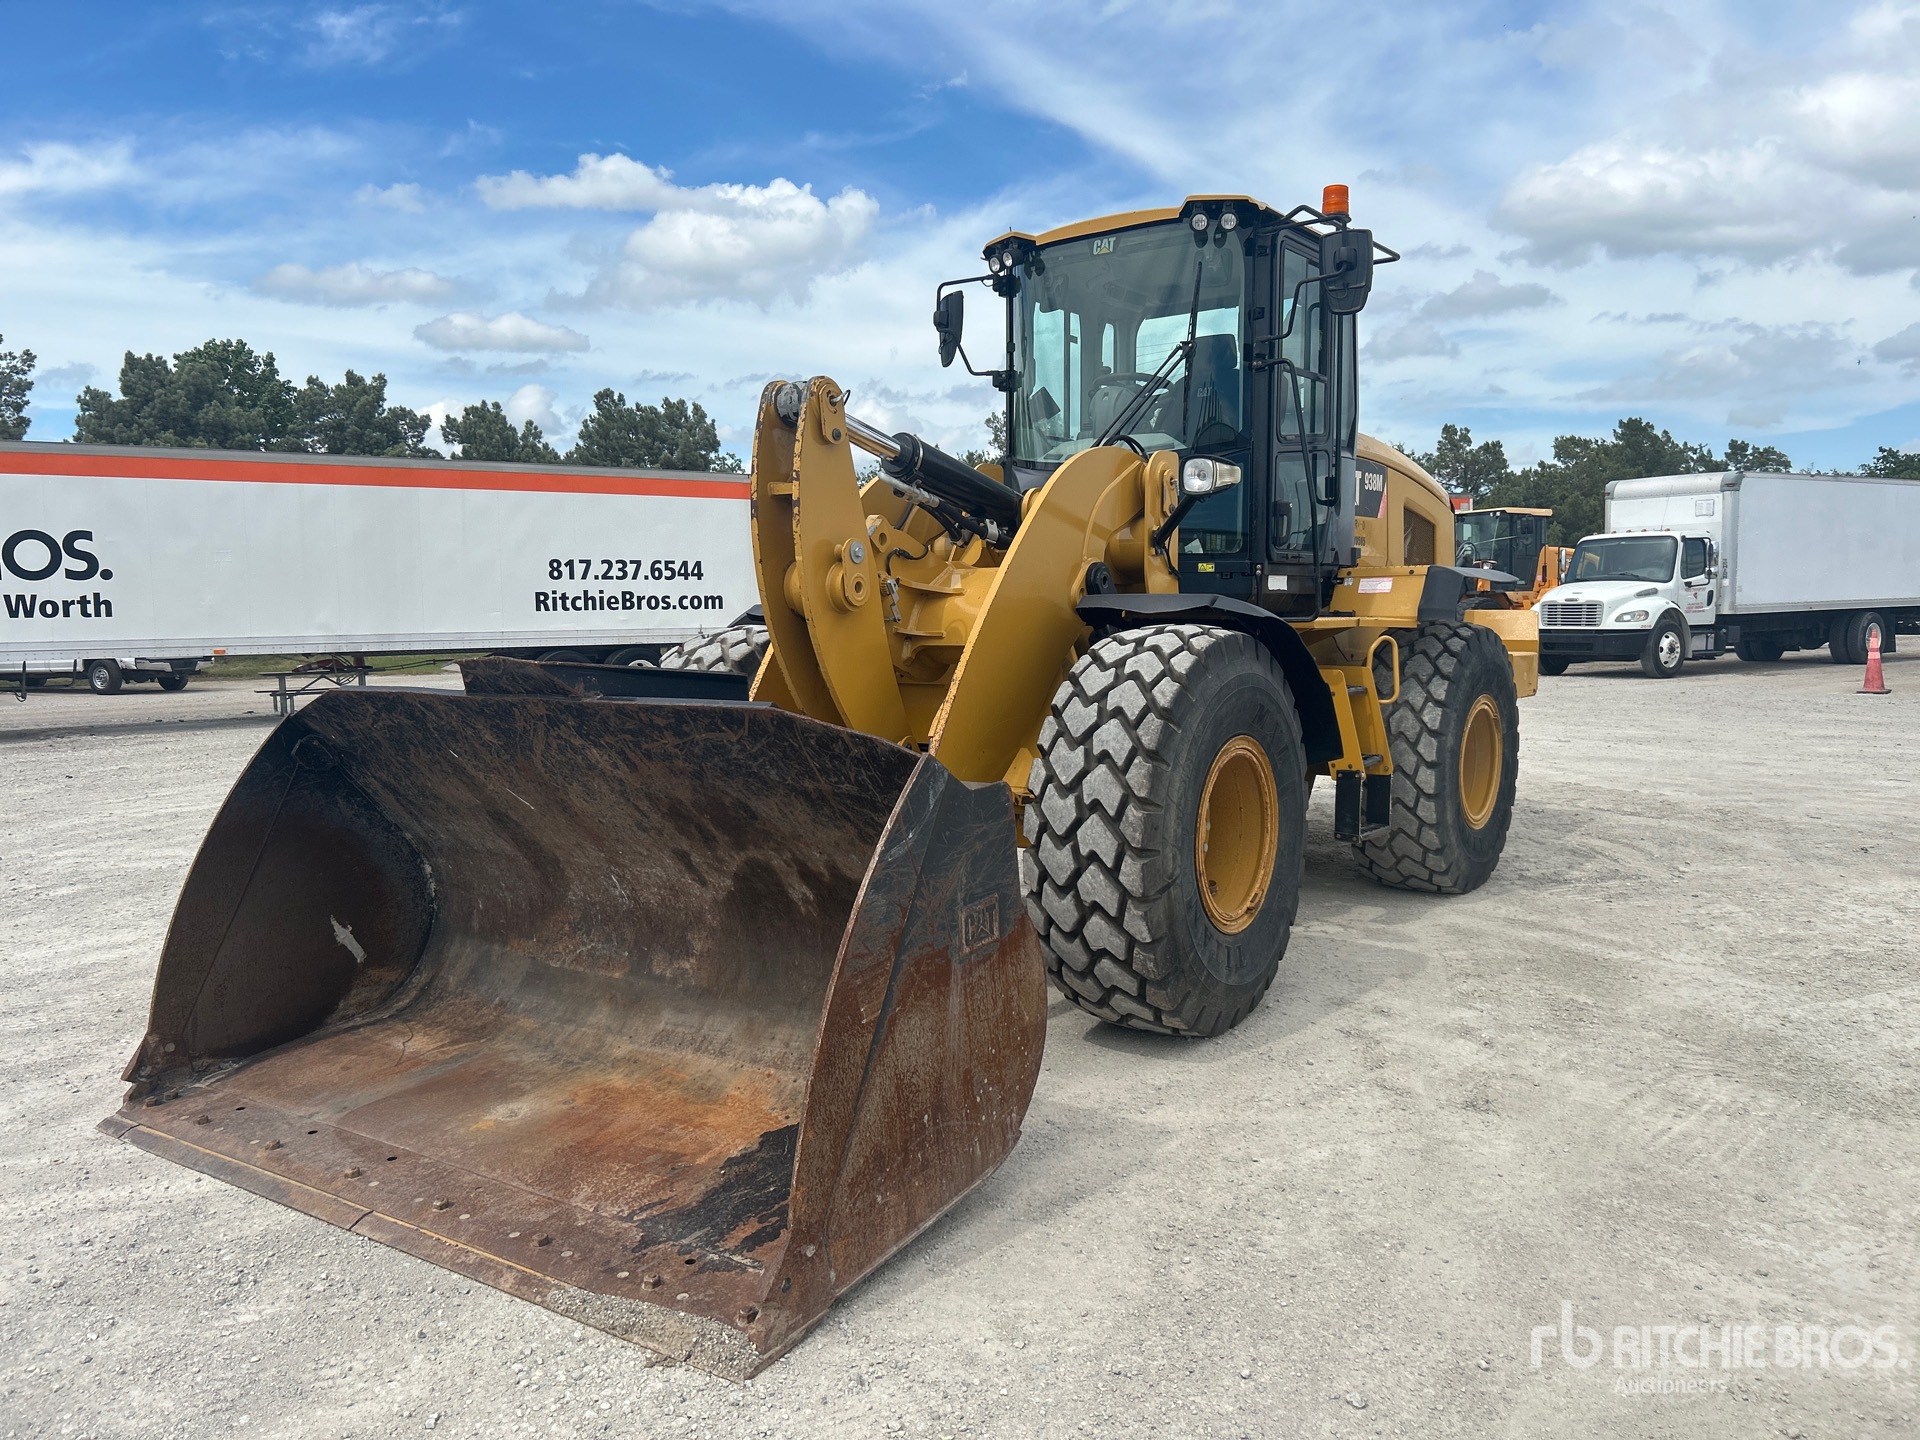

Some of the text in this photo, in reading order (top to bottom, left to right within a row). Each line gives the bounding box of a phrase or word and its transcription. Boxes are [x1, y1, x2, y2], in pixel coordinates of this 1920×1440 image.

[1093, 237, 1116, 255] CAT
[1364, 472, 1383, 492] 938M
[0, 529, 113, 581] OS.
[548, 558, 704, 581] 817.237.6544
[3, 592, 113, 619] Worth
[535, 589, 724, 612] RitchieBros.com
